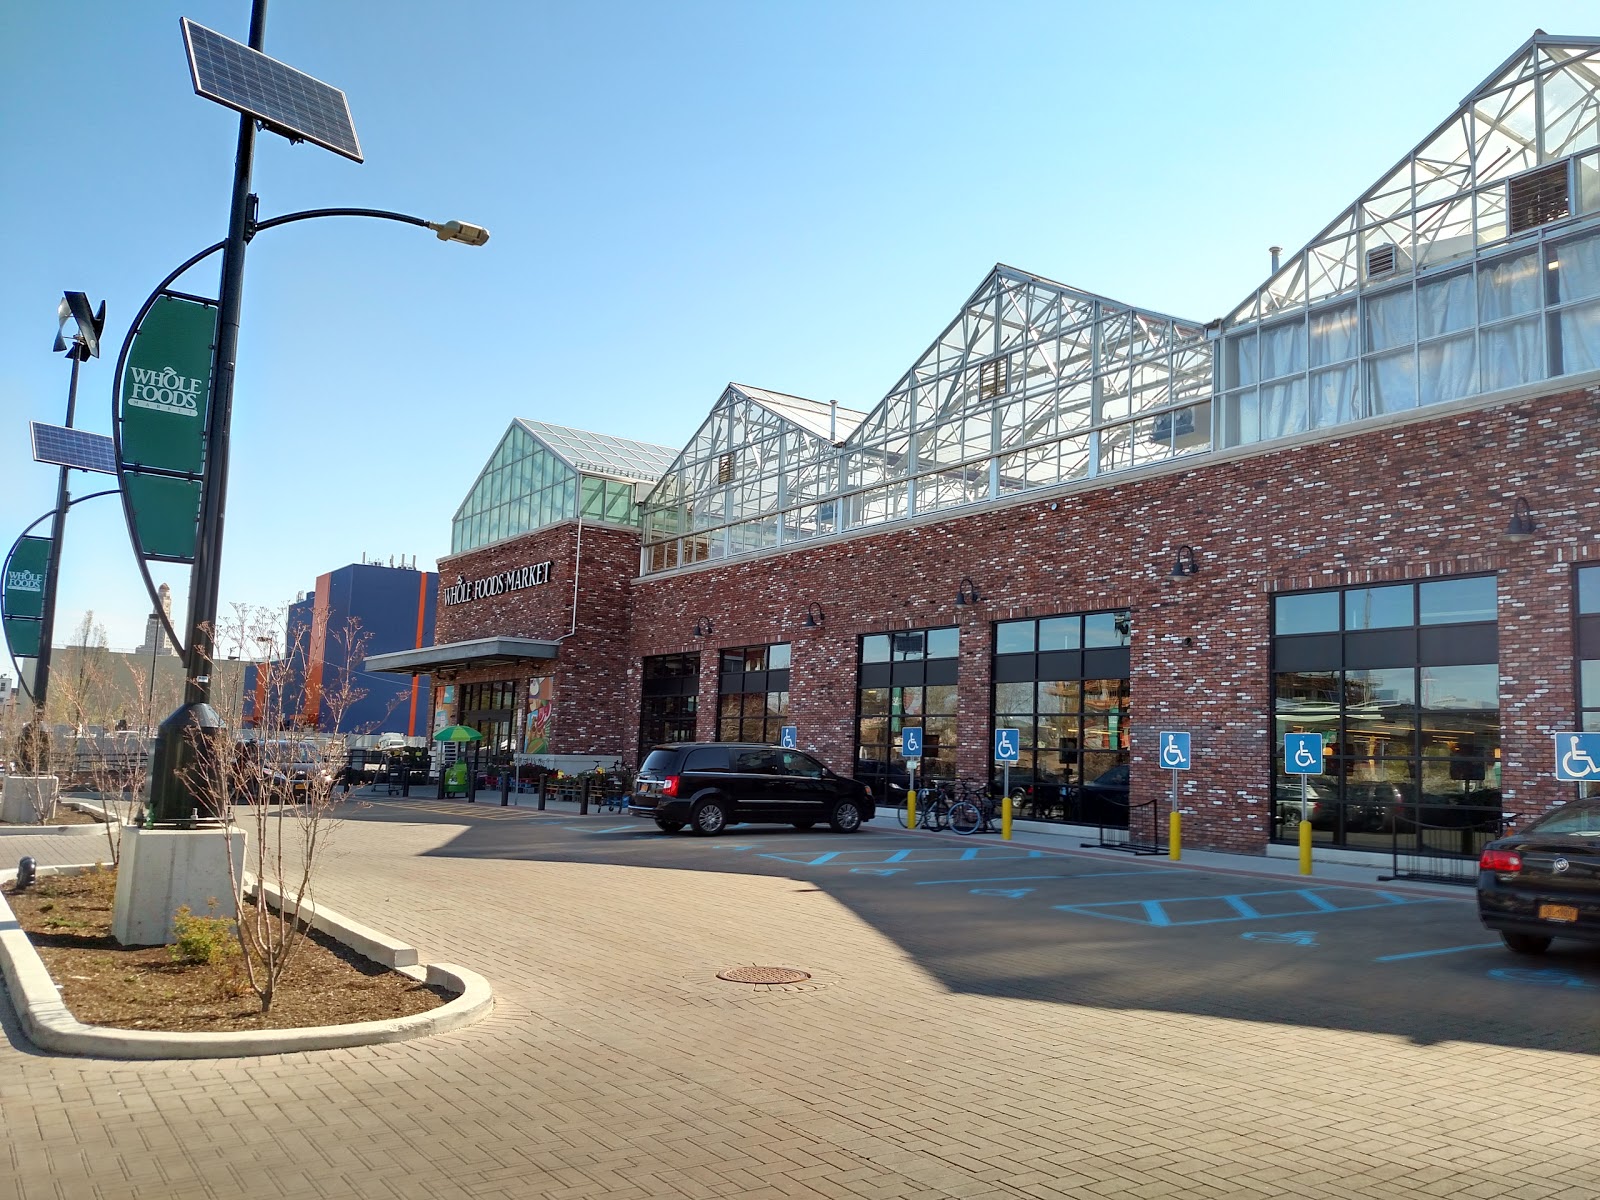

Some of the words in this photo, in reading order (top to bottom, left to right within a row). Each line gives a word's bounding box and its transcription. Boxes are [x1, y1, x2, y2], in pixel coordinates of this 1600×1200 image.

[130, 366, 202, 394] WHOLE
[131, 383, 197, 409] FOODS
[8, 570, 43, 581] WHOLE
[9, 579, 40, 588] FOODS
[444, 578, 473, 606] WHOLE
[474, 574, 504, 599] FOODS
[505, 561, 552, 592] MARKET
